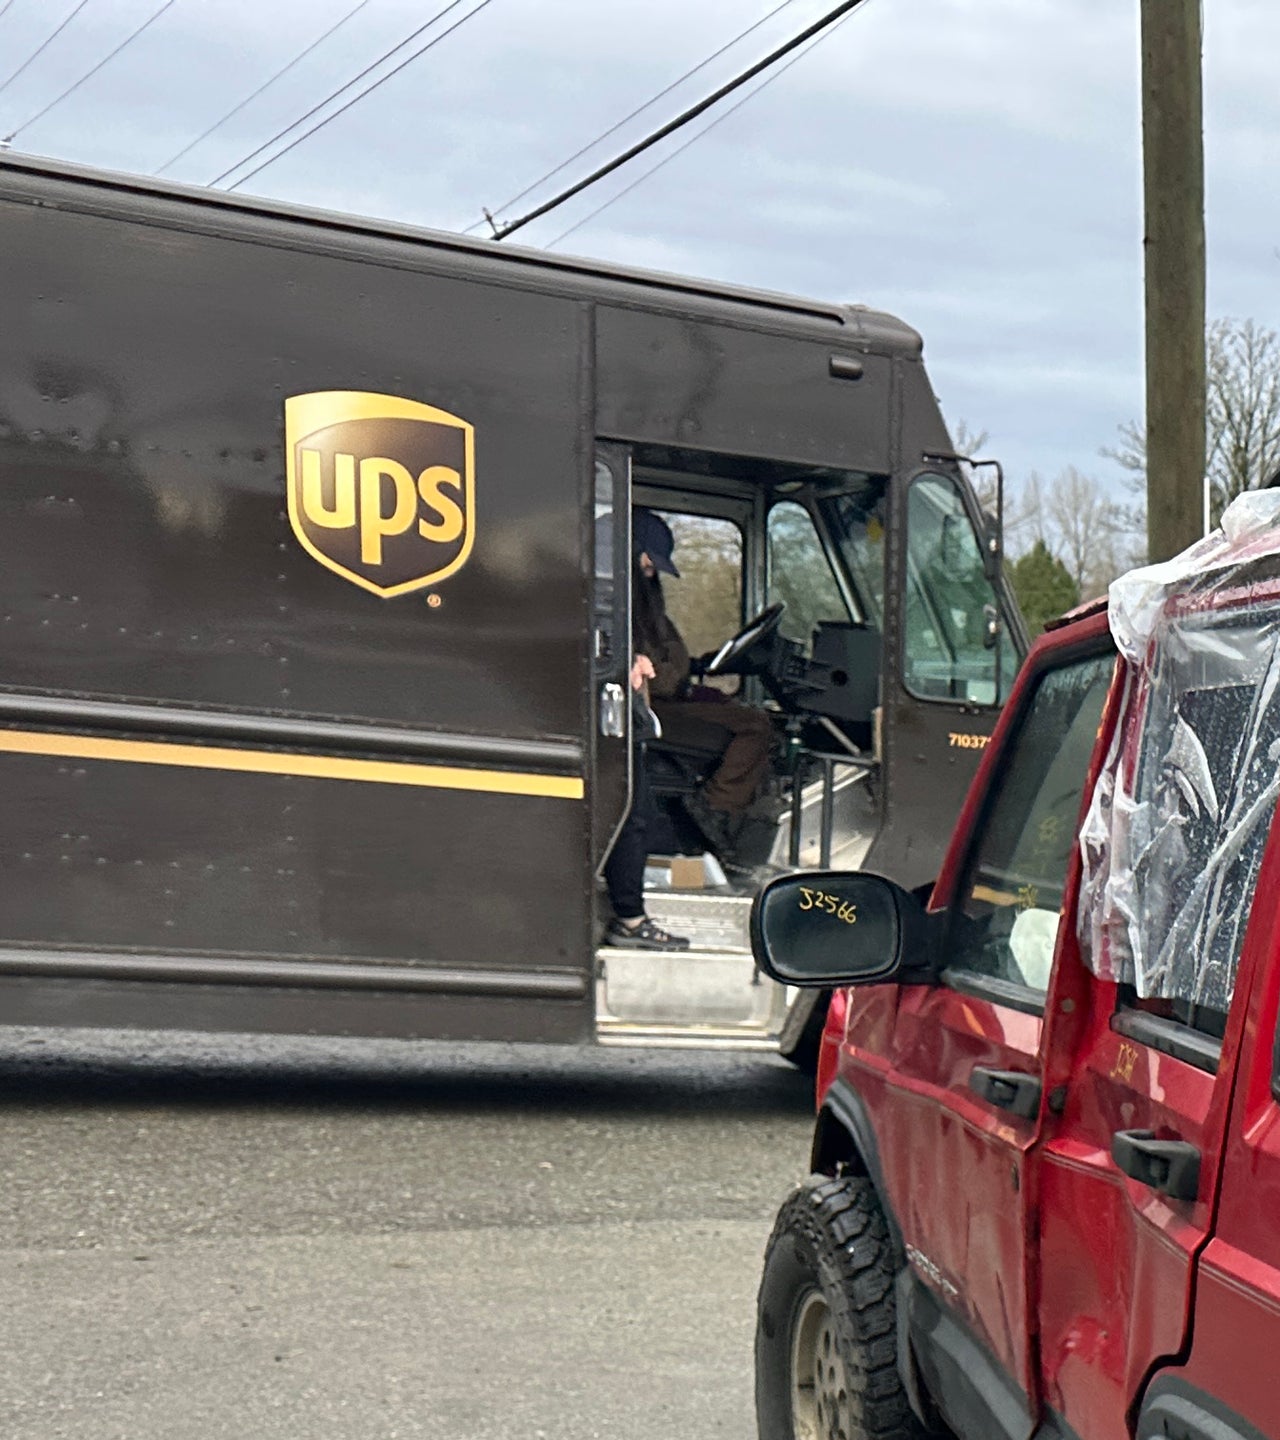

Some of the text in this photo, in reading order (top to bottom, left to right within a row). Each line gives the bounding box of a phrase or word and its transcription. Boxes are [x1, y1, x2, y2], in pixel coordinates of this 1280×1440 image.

[302, 448, 464, 565] ups
[948, 732, 992, 749] 71037
[799, 887, 857, 924] J2566
